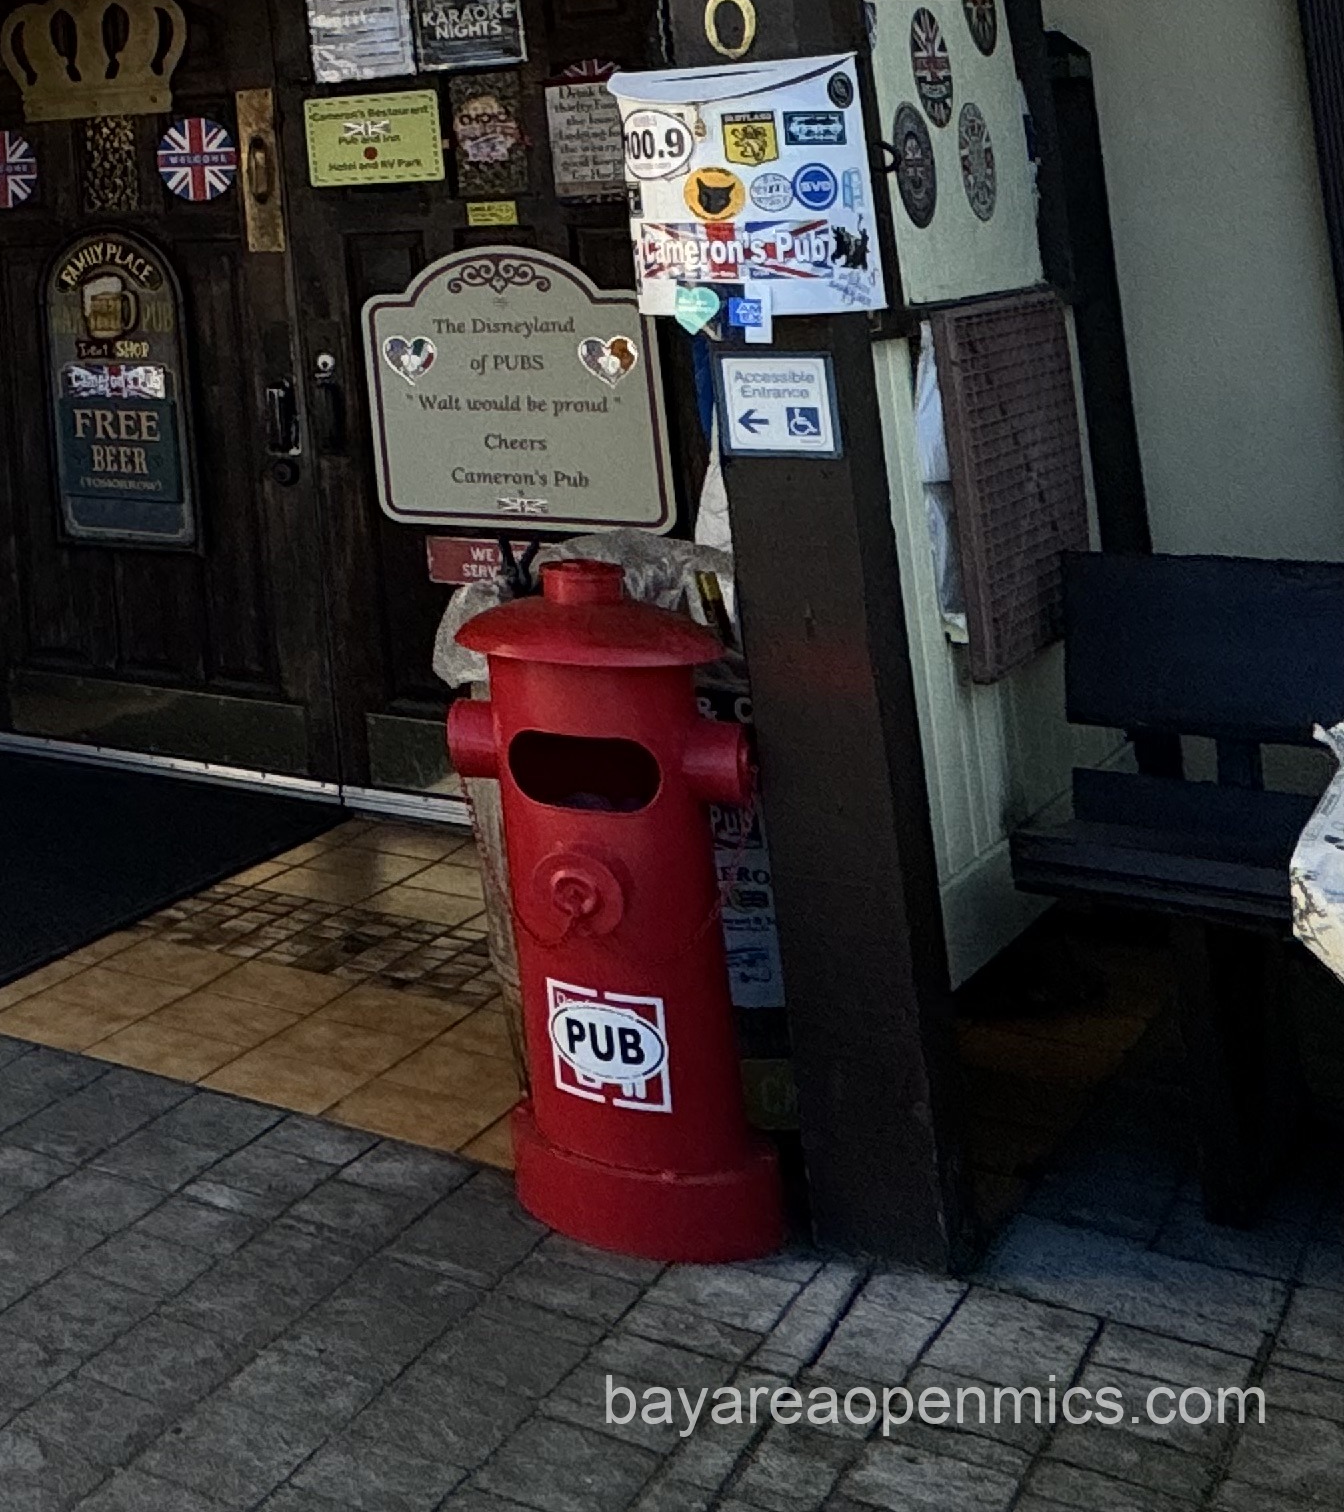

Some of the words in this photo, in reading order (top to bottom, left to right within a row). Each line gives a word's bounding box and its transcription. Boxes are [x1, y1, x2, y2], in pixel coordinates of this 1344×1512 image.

[422, 3, 514, 30] KARAOKE
[435, 21, 502, 41] NIGHTS
[169, 152, 228, 165] WELCOME
[644, 233, 767, 266] Cameron's
[775, 229, 829, 264] Pub
[60, 242, 104, 286] FAMILY
[105, 242, 155, 282] PLACE
[433, 318, 465, 335] The
[471, 316, 575, 339] Disneyland
[115, 340, 150, 359] SHOP
[469, 354, 486, 372] of
[493, 354, 545, 371] PUBS
[735, 370, 816, 384] Accessible
[740, 384, 810, 400] Entrance
[418, 394, 461, 411] Walt
[467, 395, 520, 412] would
[526, 395, 548, 412] be
[552, 396, 609, 417] proud
[73, 407, 160, 443] FREE
[484, 433, 548, 452] Cheers
[91, 444, 149, 475] BEER
[451, 466, 548, 486] Cameron's
[553, 470, 590, 489] Pub
[566, 1016, 647, 1066] PUB
